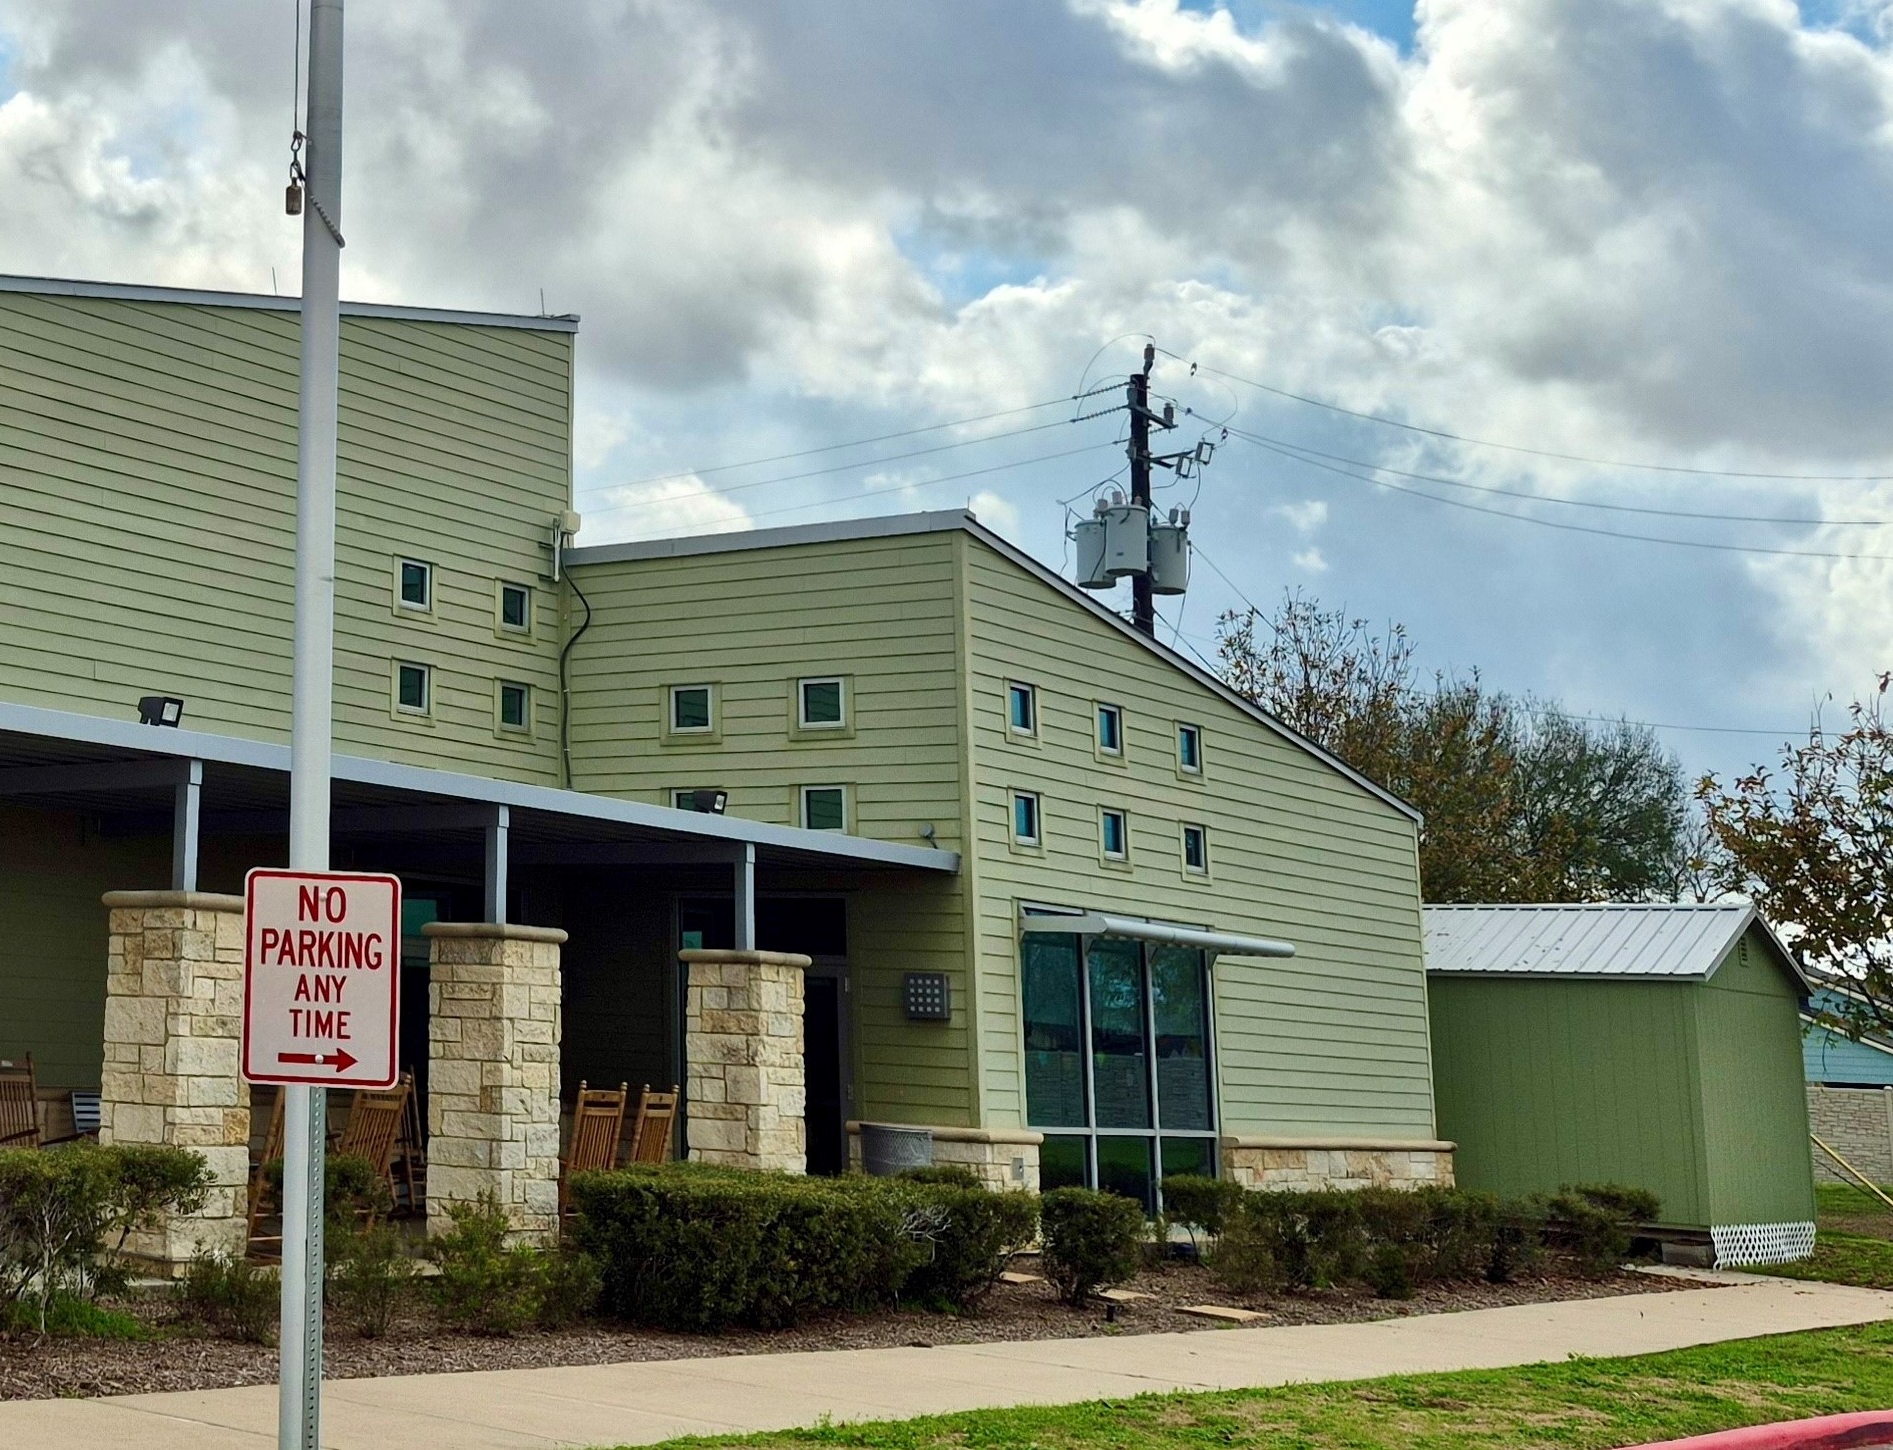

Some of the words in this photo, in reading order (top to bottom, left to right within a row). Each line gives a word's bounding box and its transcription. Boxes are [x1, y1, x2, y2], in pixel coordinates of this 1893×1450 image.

[298, 884, 346, 924] NO
[260, 928, 383, 970] PARKING
[294, 974, 347, 1004] ANY
[289, 1008, 351, 1040] TIME
